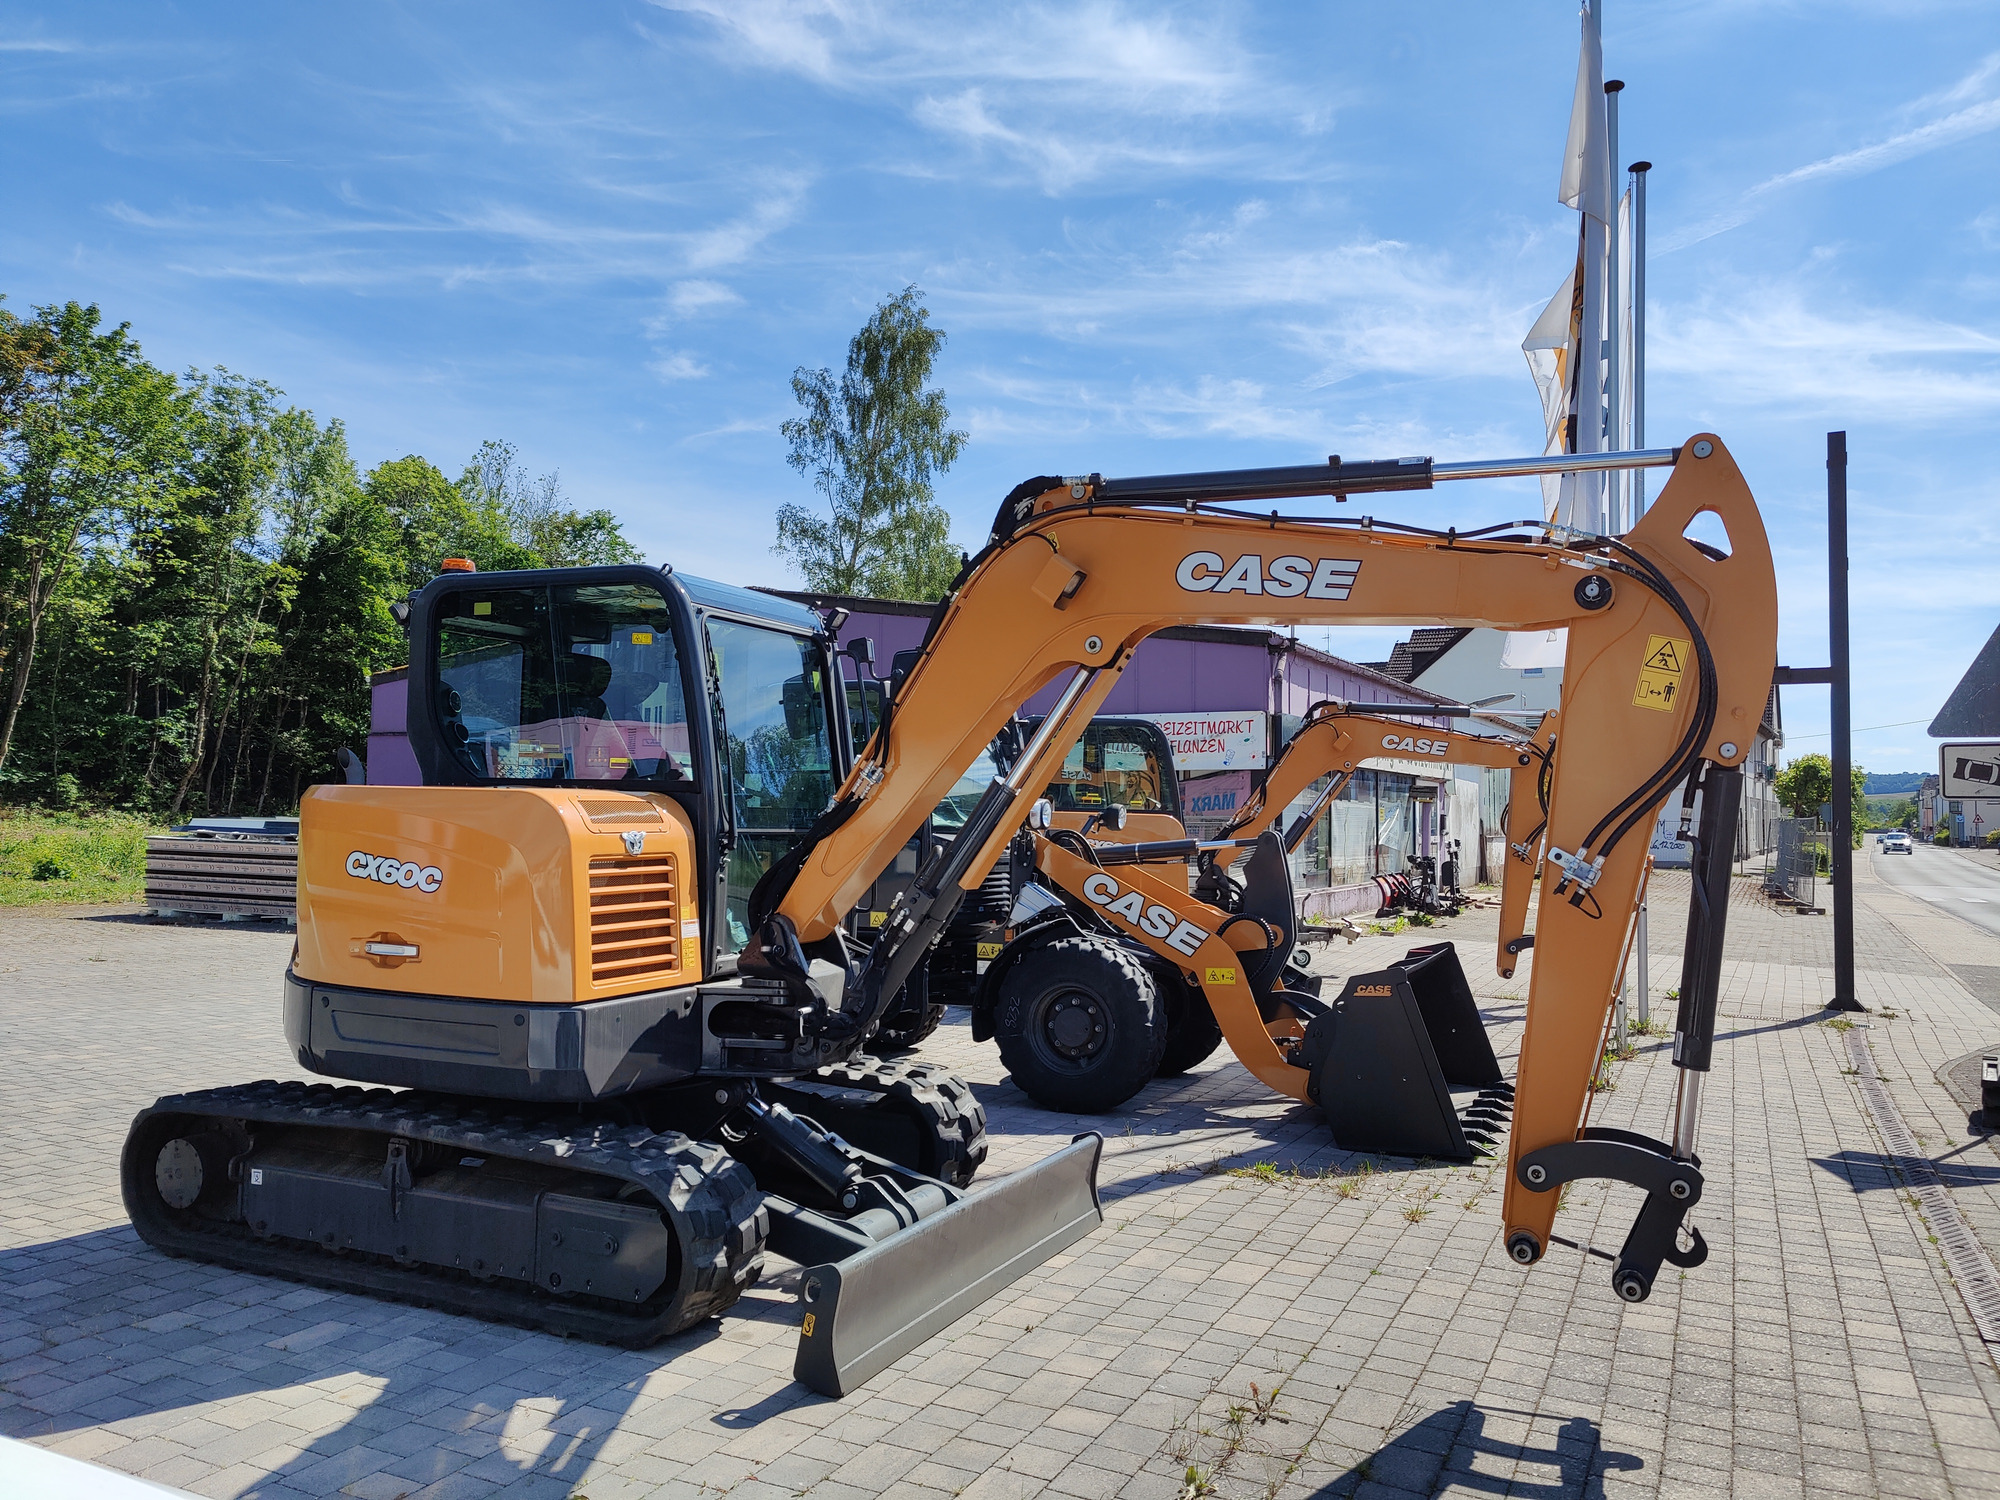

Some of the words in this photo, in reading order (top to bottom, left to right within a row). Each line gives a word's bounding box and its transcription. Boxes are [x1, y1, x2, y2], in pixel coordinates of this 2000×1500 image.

[1175, 550, 1363, 601] CASE
[1169, 739, 1225, 754] FLANZEN
[1381, 734, 1449, 756] CASE
[345, 850, 443, 894] CX60C
[1082, 872, 1211, 958] CASE
[1356, 984, 1392, 994] CASE
